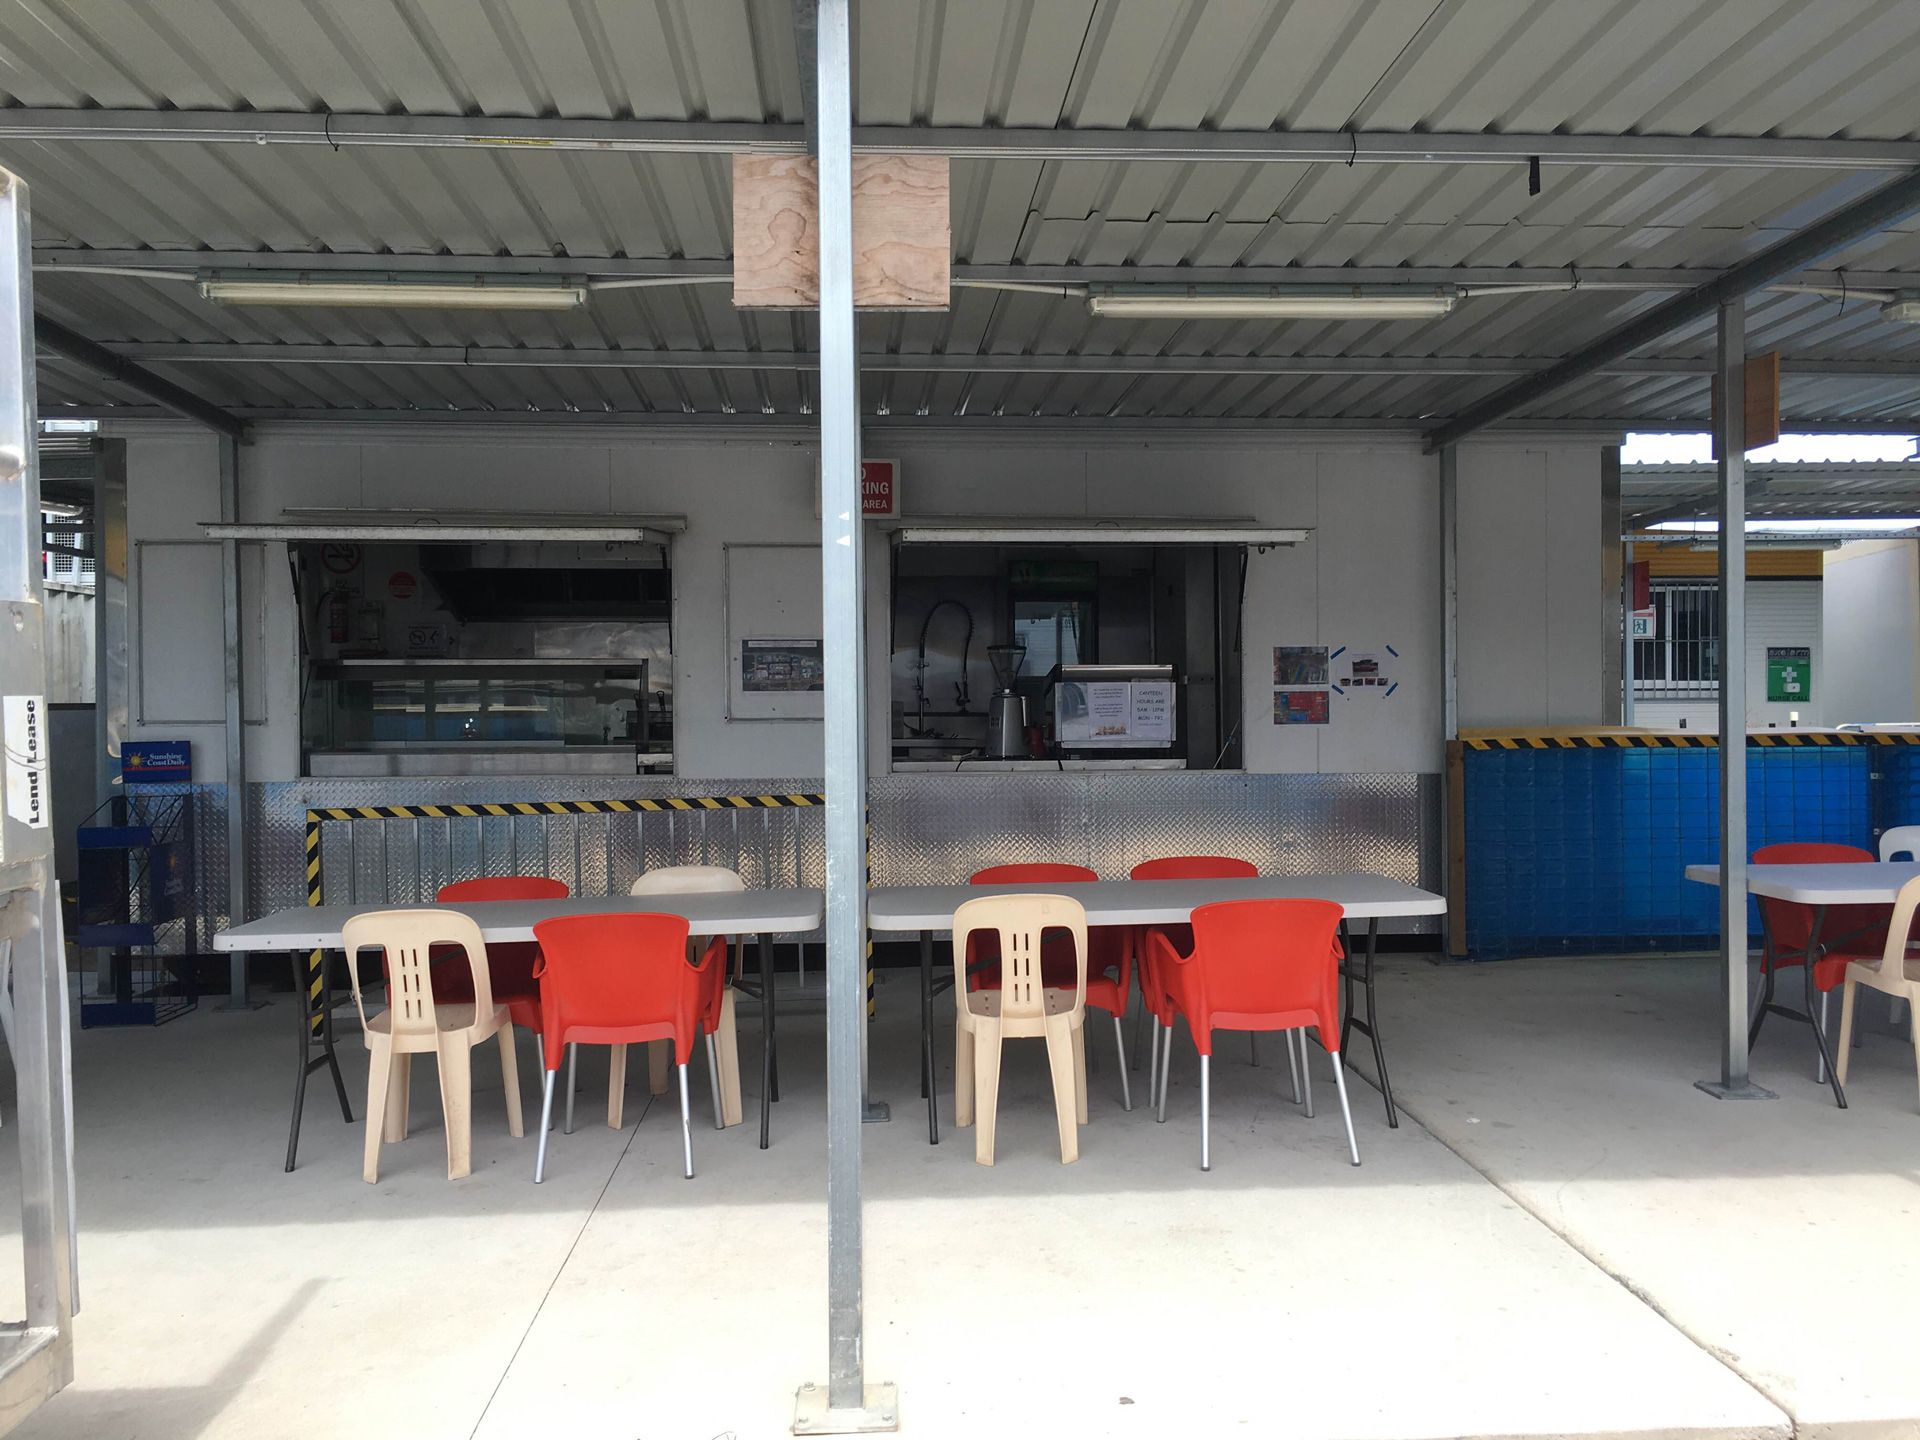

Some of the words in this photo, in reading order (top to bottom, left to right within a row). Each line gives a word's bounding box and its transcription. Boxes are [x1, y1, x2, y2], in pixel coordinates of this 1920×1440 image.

[862, 500, 888, 509] AREA
[26, 699, 37, 764] Lease
[149, 752, 183, 760] Sunshine
[167, 759, 186, 767] Daily
[27, 771, 40, 825] Lend
